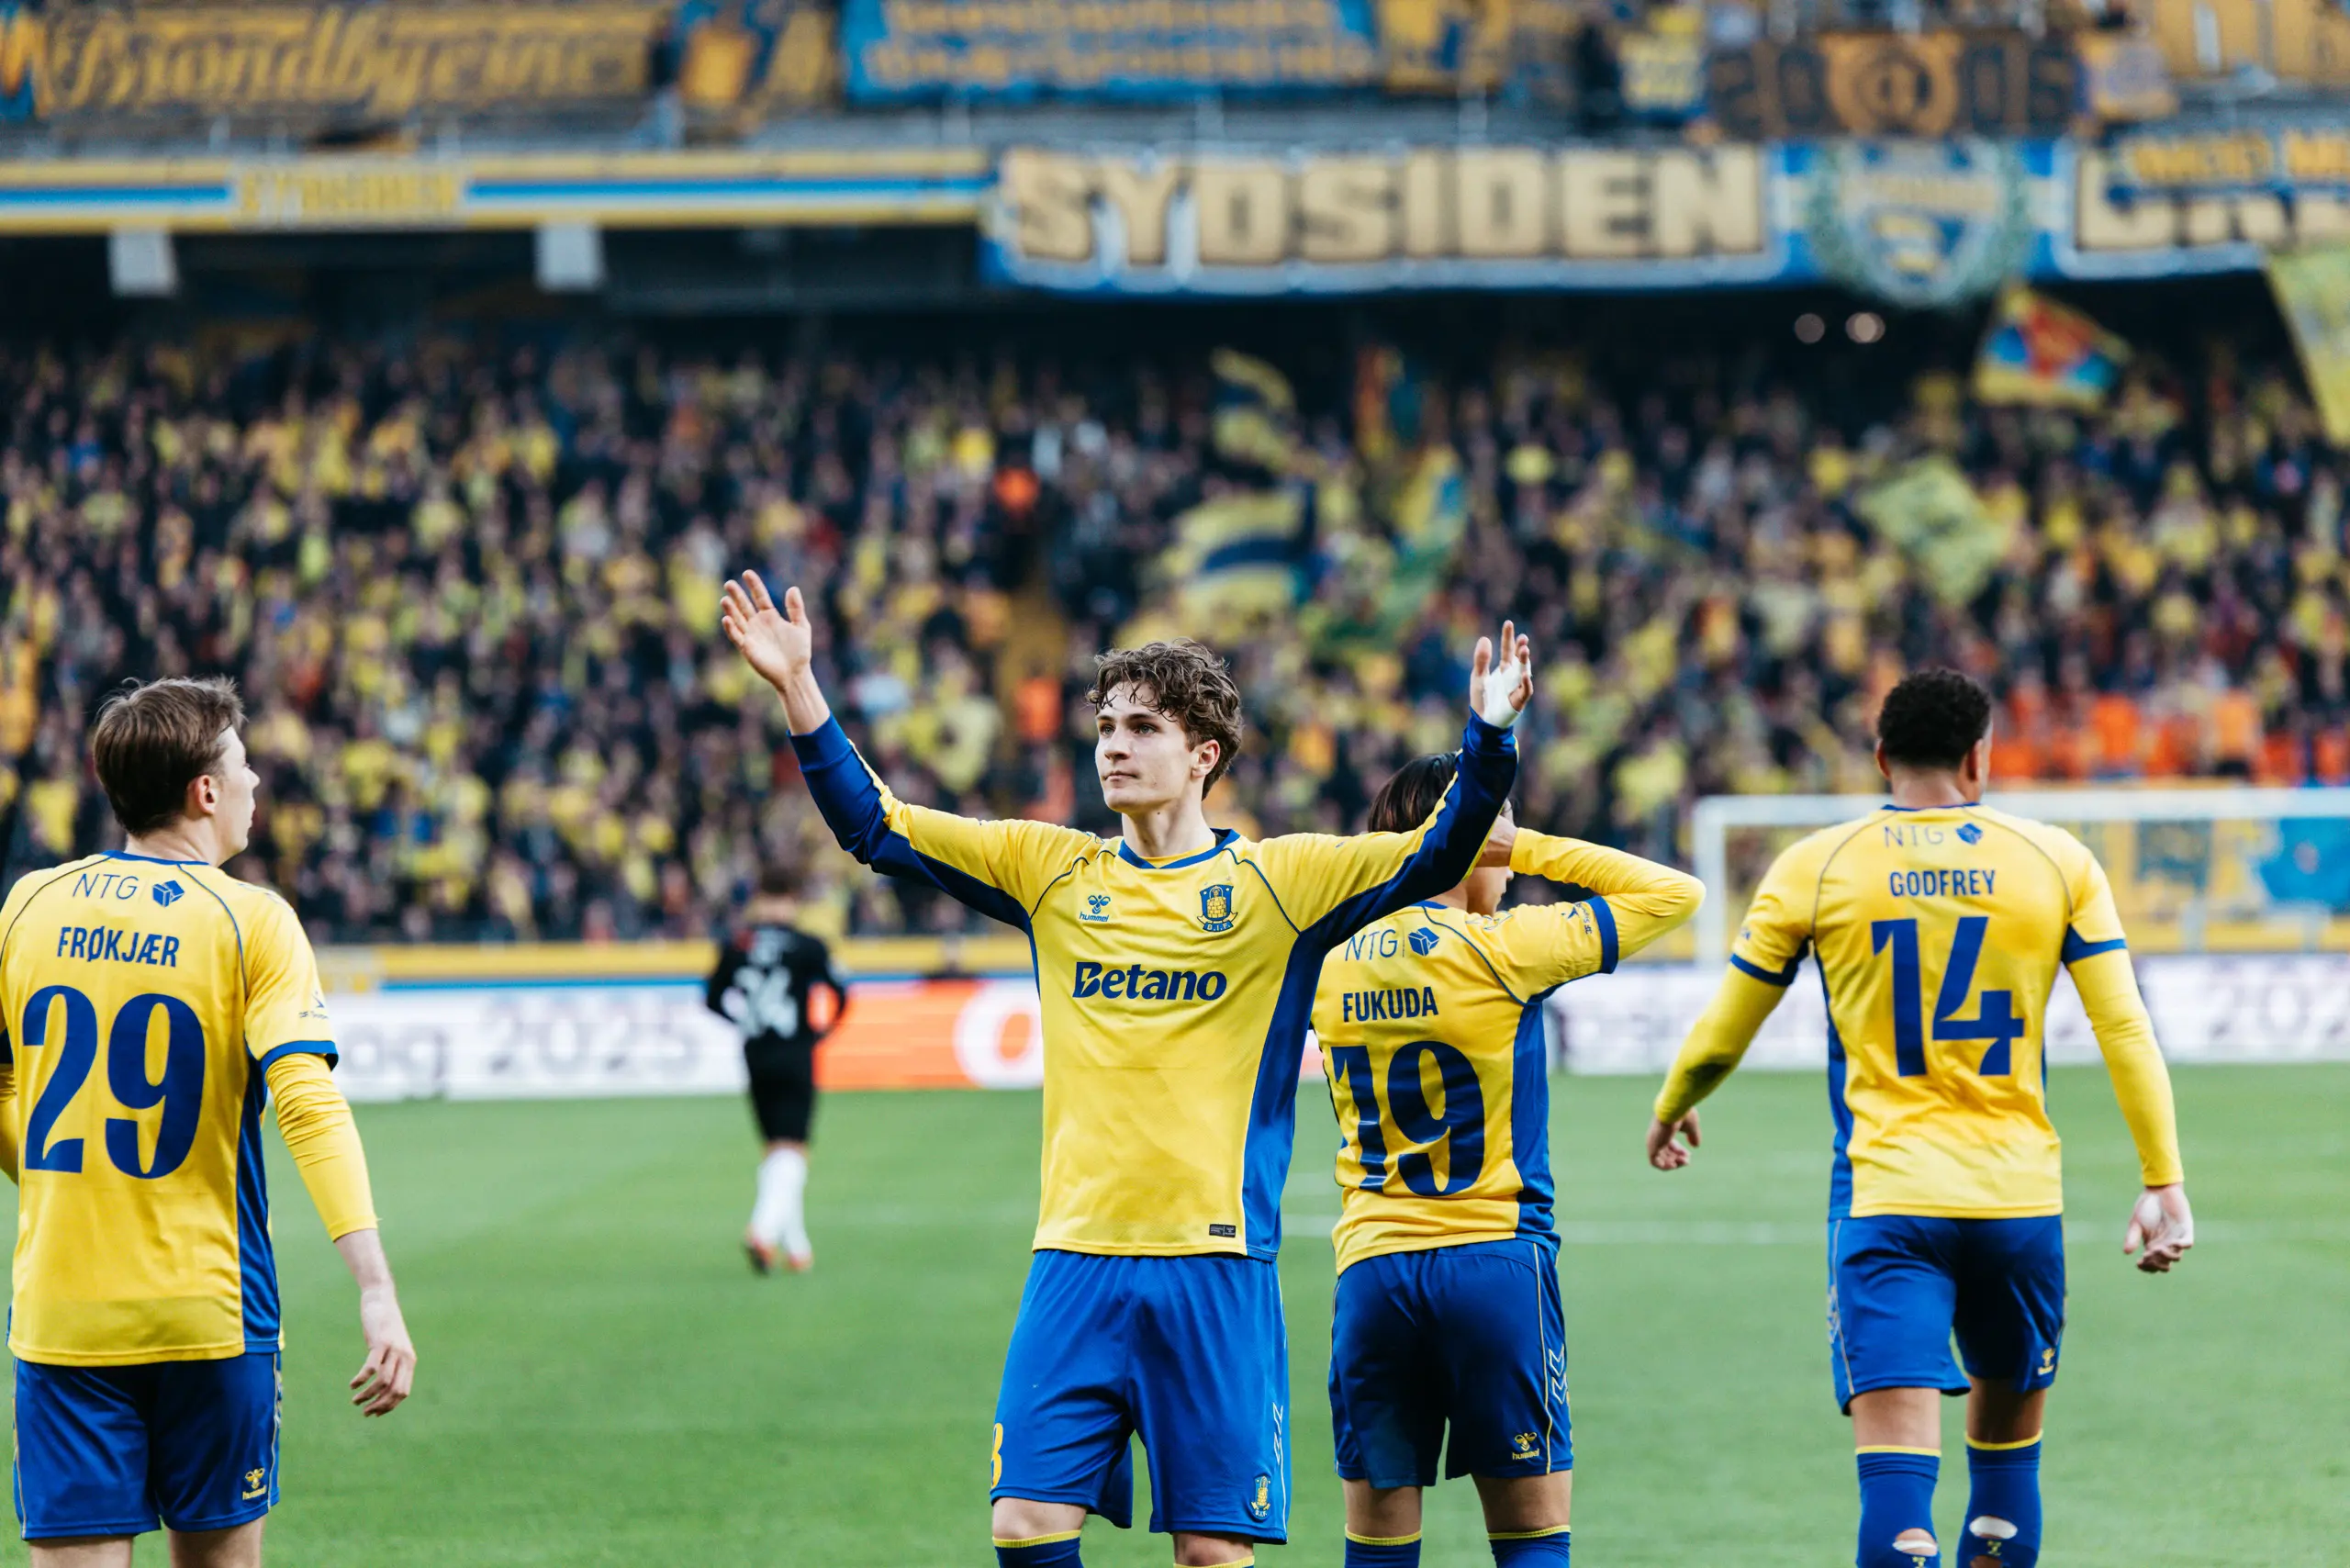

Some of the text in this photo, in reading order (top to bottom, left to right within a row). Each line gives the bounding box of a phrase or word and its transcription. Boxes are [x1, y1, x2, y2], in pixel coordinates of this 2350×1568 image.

[1001, 149, 1764, 264] SYDSIDEN
[1885, 824, 1944, 847] NTG
[72, 873, 139, 900] NTG
[1889, 868, 1996, 897] GODFREY
[1079, 912, 1110, 923] hummel
[57, 925, 179, 968] FRØKJÆR
[1345, 928, 1398, 961] NTG
[1072, 961, 1227, 1002] Betano
[1871, 916, 2024, 1077] 14
[1343, 986, 1439, 1023] FUKUDA
[22, 984, 206, 1180] 29
[1331, 1040, 1485, 1196] 19
